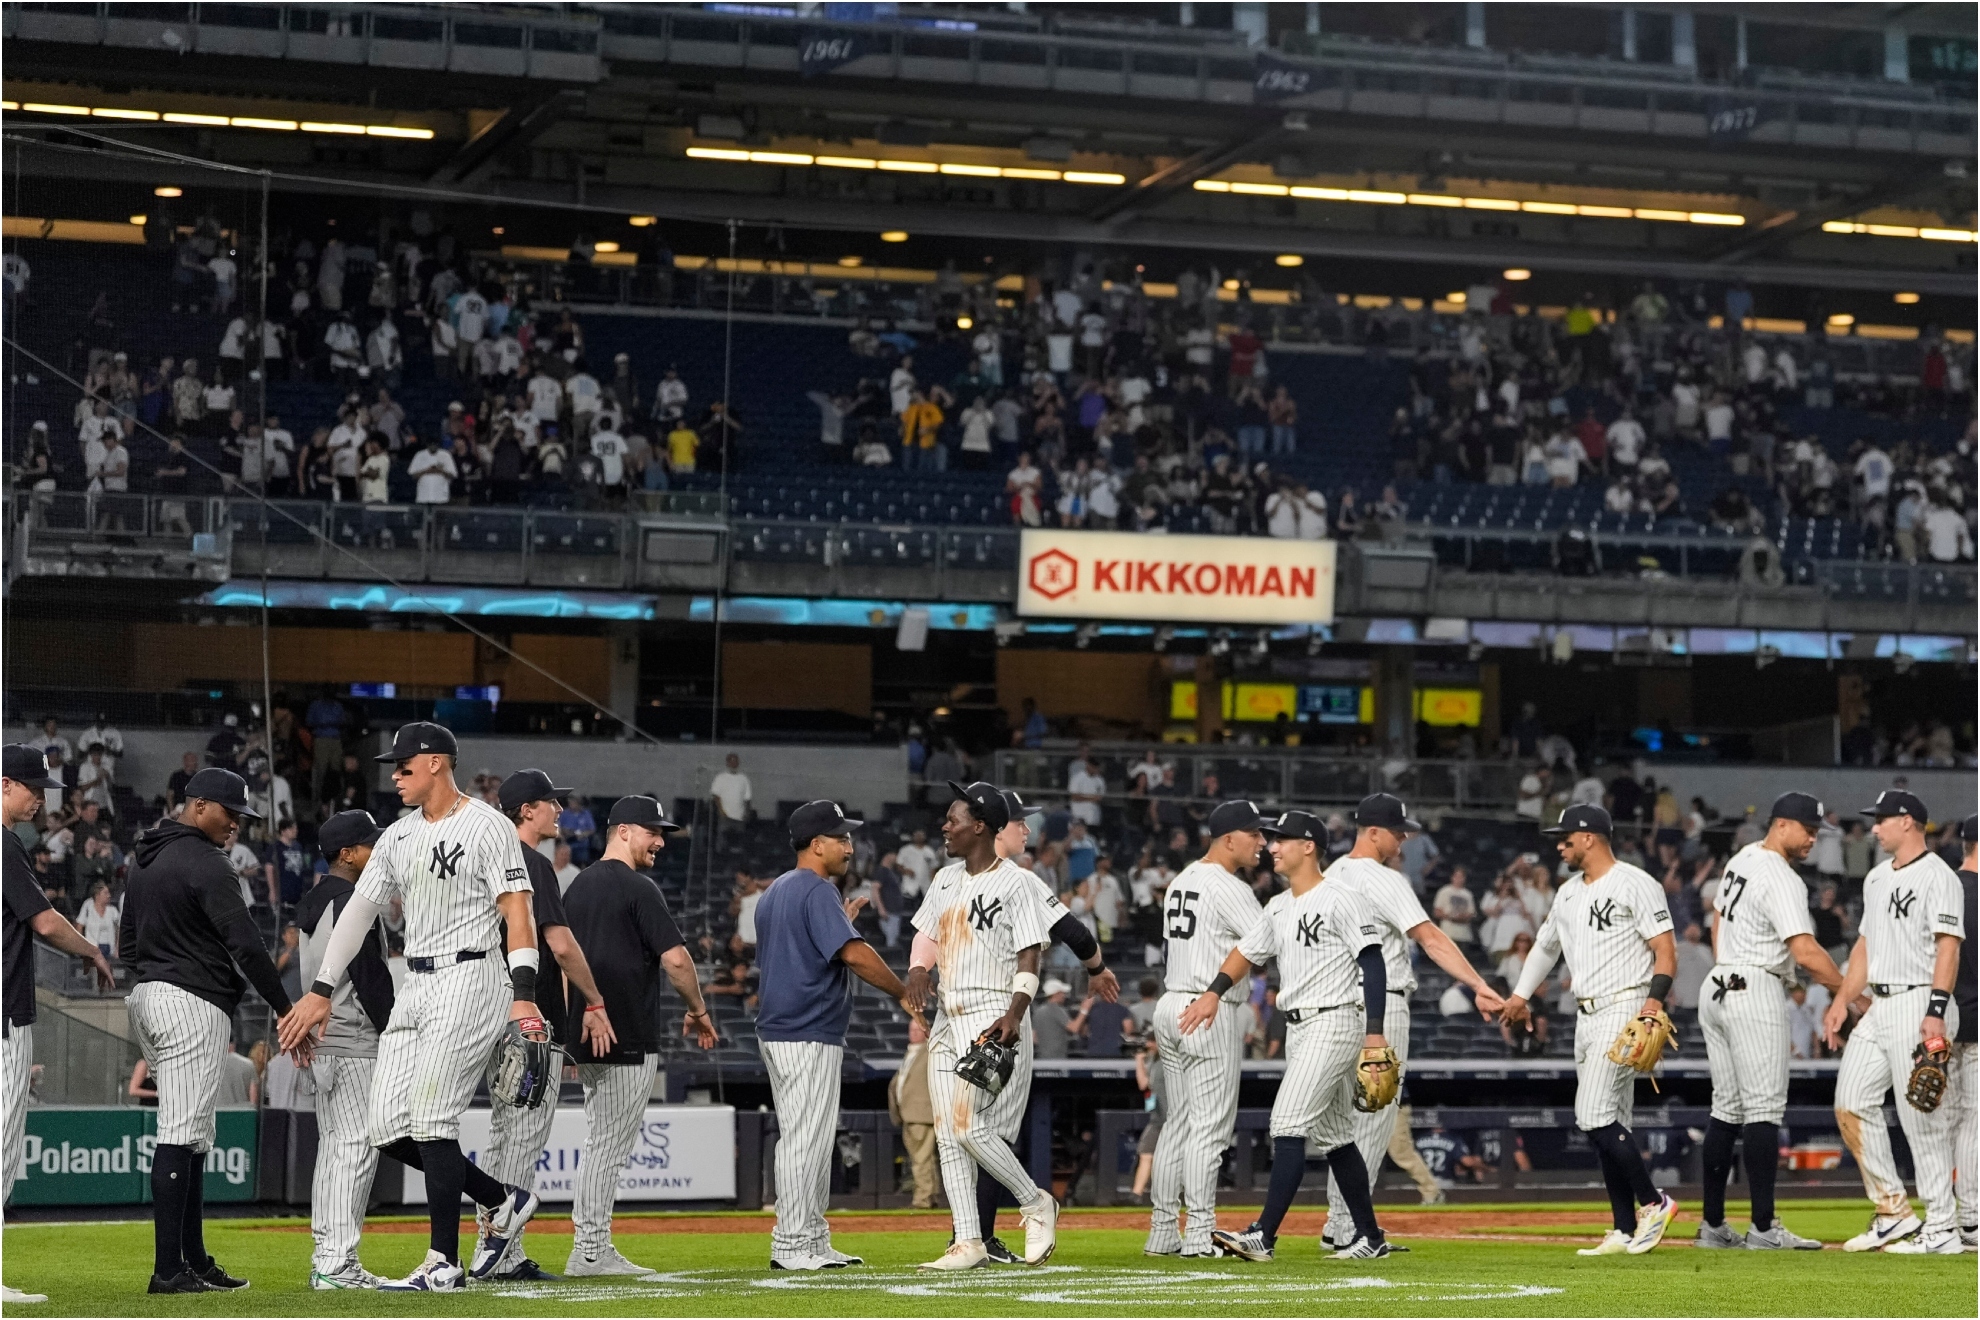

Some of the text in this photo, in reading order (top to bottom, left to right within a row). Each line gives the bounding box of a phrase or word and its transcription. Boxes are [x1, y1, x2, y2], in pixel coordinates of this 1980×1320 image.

[803, 38, 853, 62] 1961
[1093, 560, 1315, 598] KIKKOMAN
[429, 841, 465, 879] NY
[968, 894, 1002, 931] NY
[1589, 898, 1615, 931] NY
[1720, 870, 1747, 922] 27
[1888, 887, 1916, 919] NY
[1167, 890, 1199, 940] 25
[1296, 912, 1324, 947] NY
[16, 1134, 131, 1180] Poland
[136, 1135, 246, 1184] Sng
[618, 1177, 692, 1189] COMPANY
